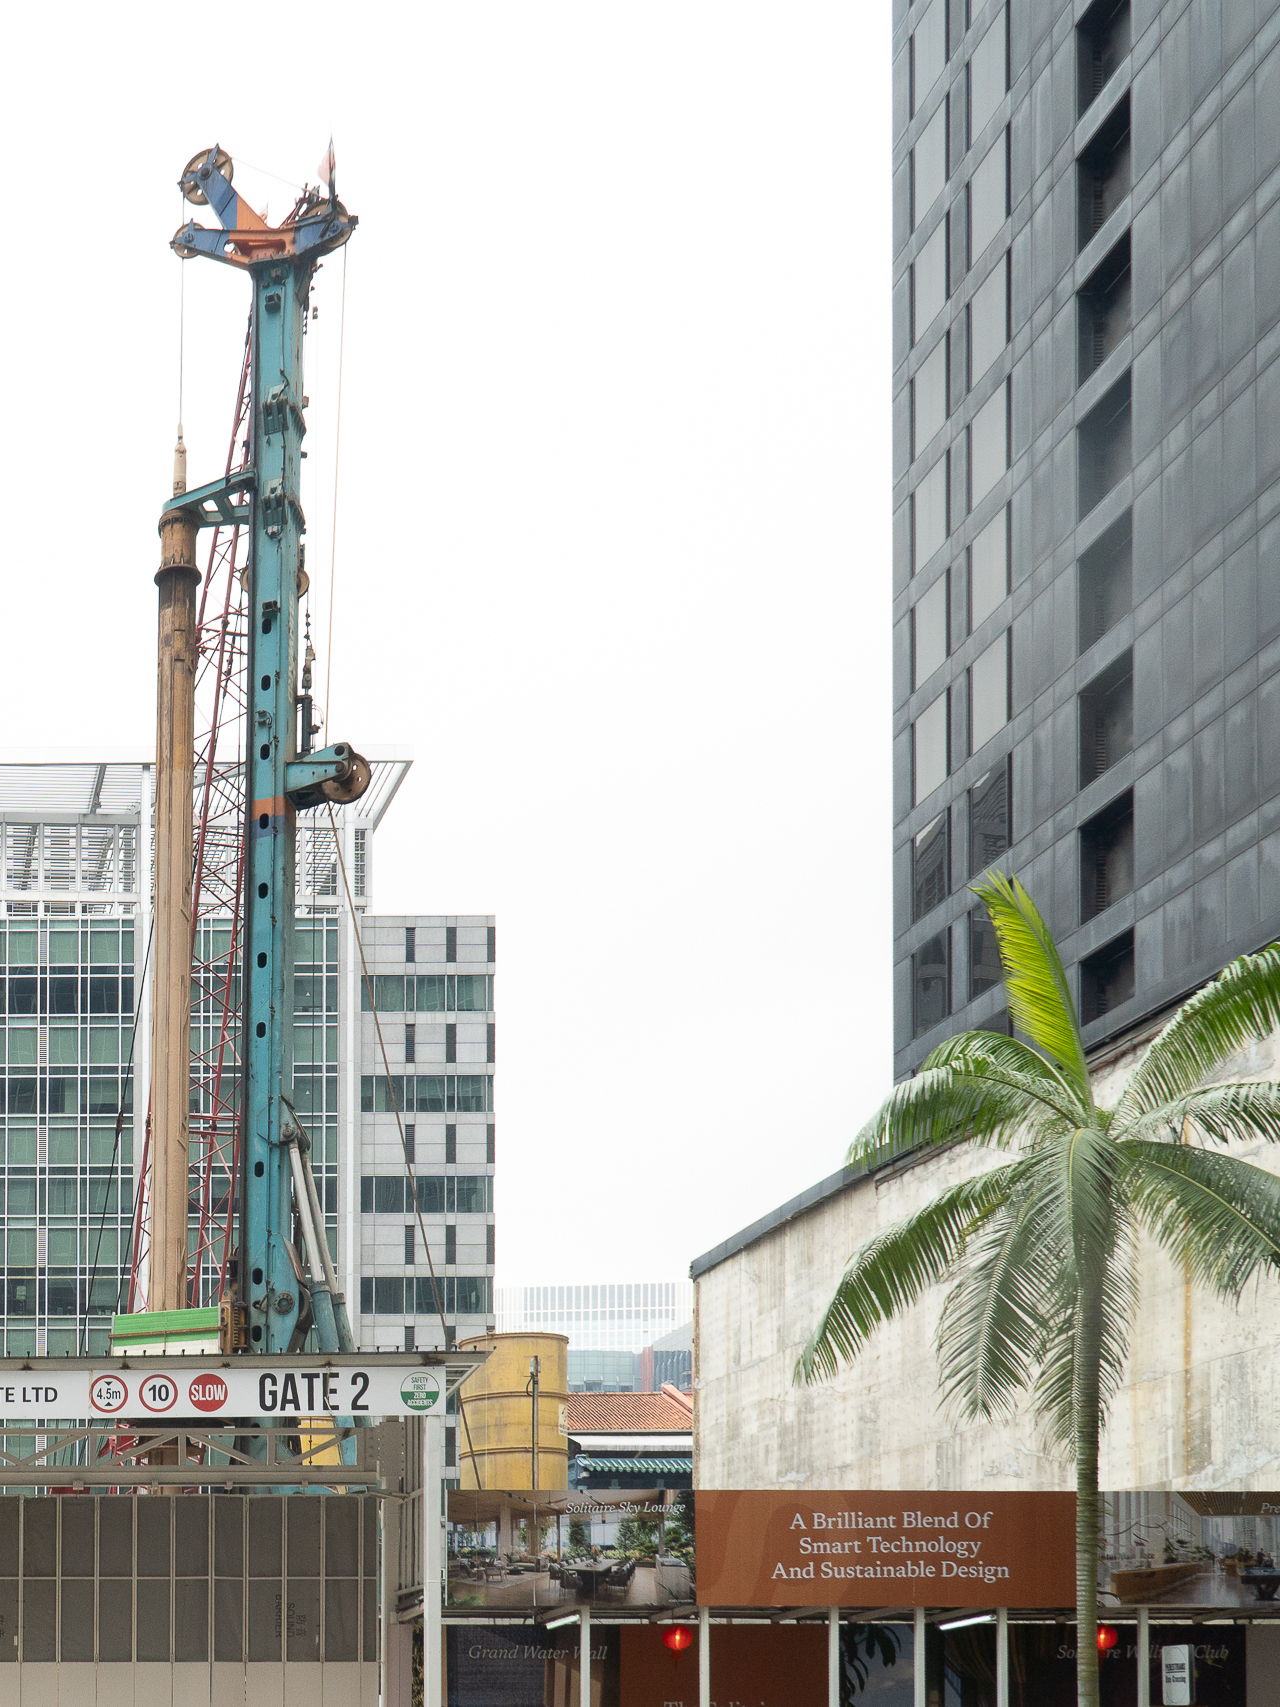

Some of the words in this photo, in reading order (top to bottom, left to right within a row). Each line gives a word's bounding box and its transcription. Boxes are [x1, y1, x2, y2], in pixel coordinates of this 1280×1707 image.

[410, 1376, 429, 1384] SAFETY
[22, 1386, 58, 1403] LTD
[96, 1387, 121, 1400] 4.5m
[148, 1384, 170, 1402] 10
[190, 1384, 226, 1401] SLOW
[258, 1372, 340, 1412] GATE
[350, 1371, 370, 1411] 2
[413, 1391, 427, 1399] ZERO
[406, 1399, 434, 1407] ACCIDENTS
[565, 1501, 616, 1514] Solitaire
[619, 1501, 641, 1516] Sky
[643, 1501, 687, 1516] Lounge
[789, 1512, 807, 1530] A
[812, 1511, 897, 1530] Brilliant
[902, 1511, 959, 1529] Blend
[964, 1511, 993, 1529] Of
[799, 1537, 862, 1555] Smart
[866, 1536, 982, 1559] Technology
[770, 1562, 815, 1579] And
[820, 1560, 936, 1579] Sustainable
[940, 1561, 1010, 1584] Design
[286, 1602, 295, 1638] SOUND
[468, 1644, 519, 1659] Grand
[523, 1644, 569, 1660] Water
[1194, 1644, 1230, 1660] Club
